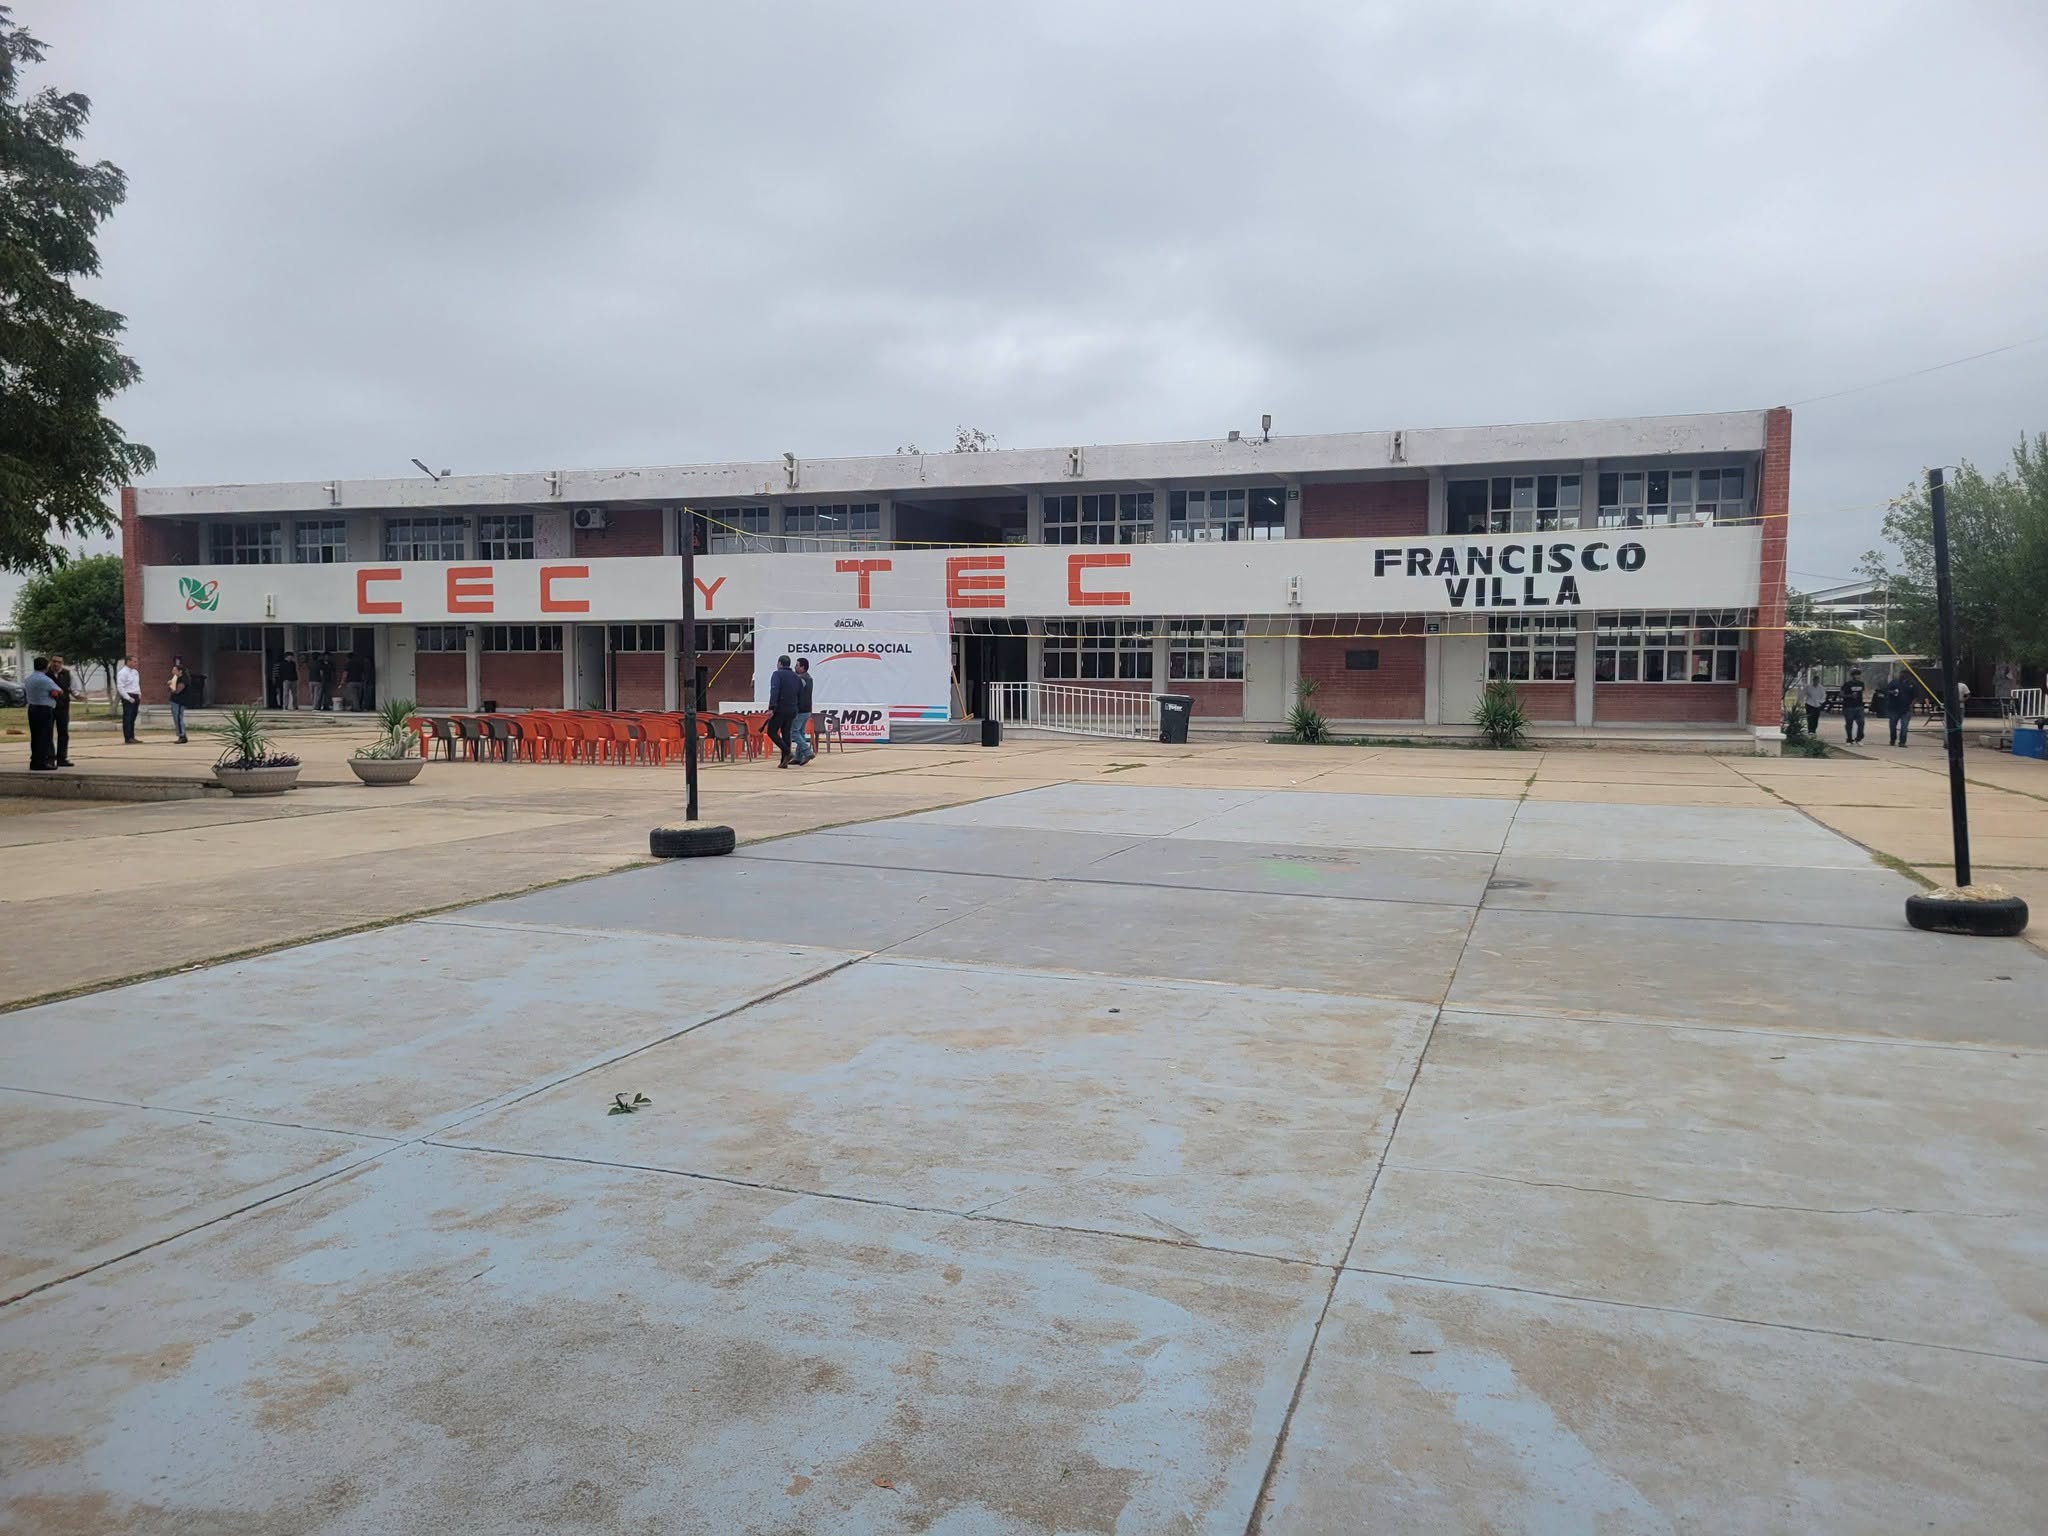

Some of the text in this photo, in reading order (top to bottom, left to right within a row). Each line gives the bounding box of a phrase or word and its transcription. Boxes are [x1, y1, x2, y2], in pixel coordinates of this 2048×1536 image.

[1374, 542, 1646, 577] FRANCISCO
[693, 577, 727, 611] Y
[1444, 575, 1581, 608] VILLA
[840, 618, 865, 628] ACUÑA
[787, 643, 912, 654] DESARROLLO SOCIAL
[841, 709, 882, 724] MDP
